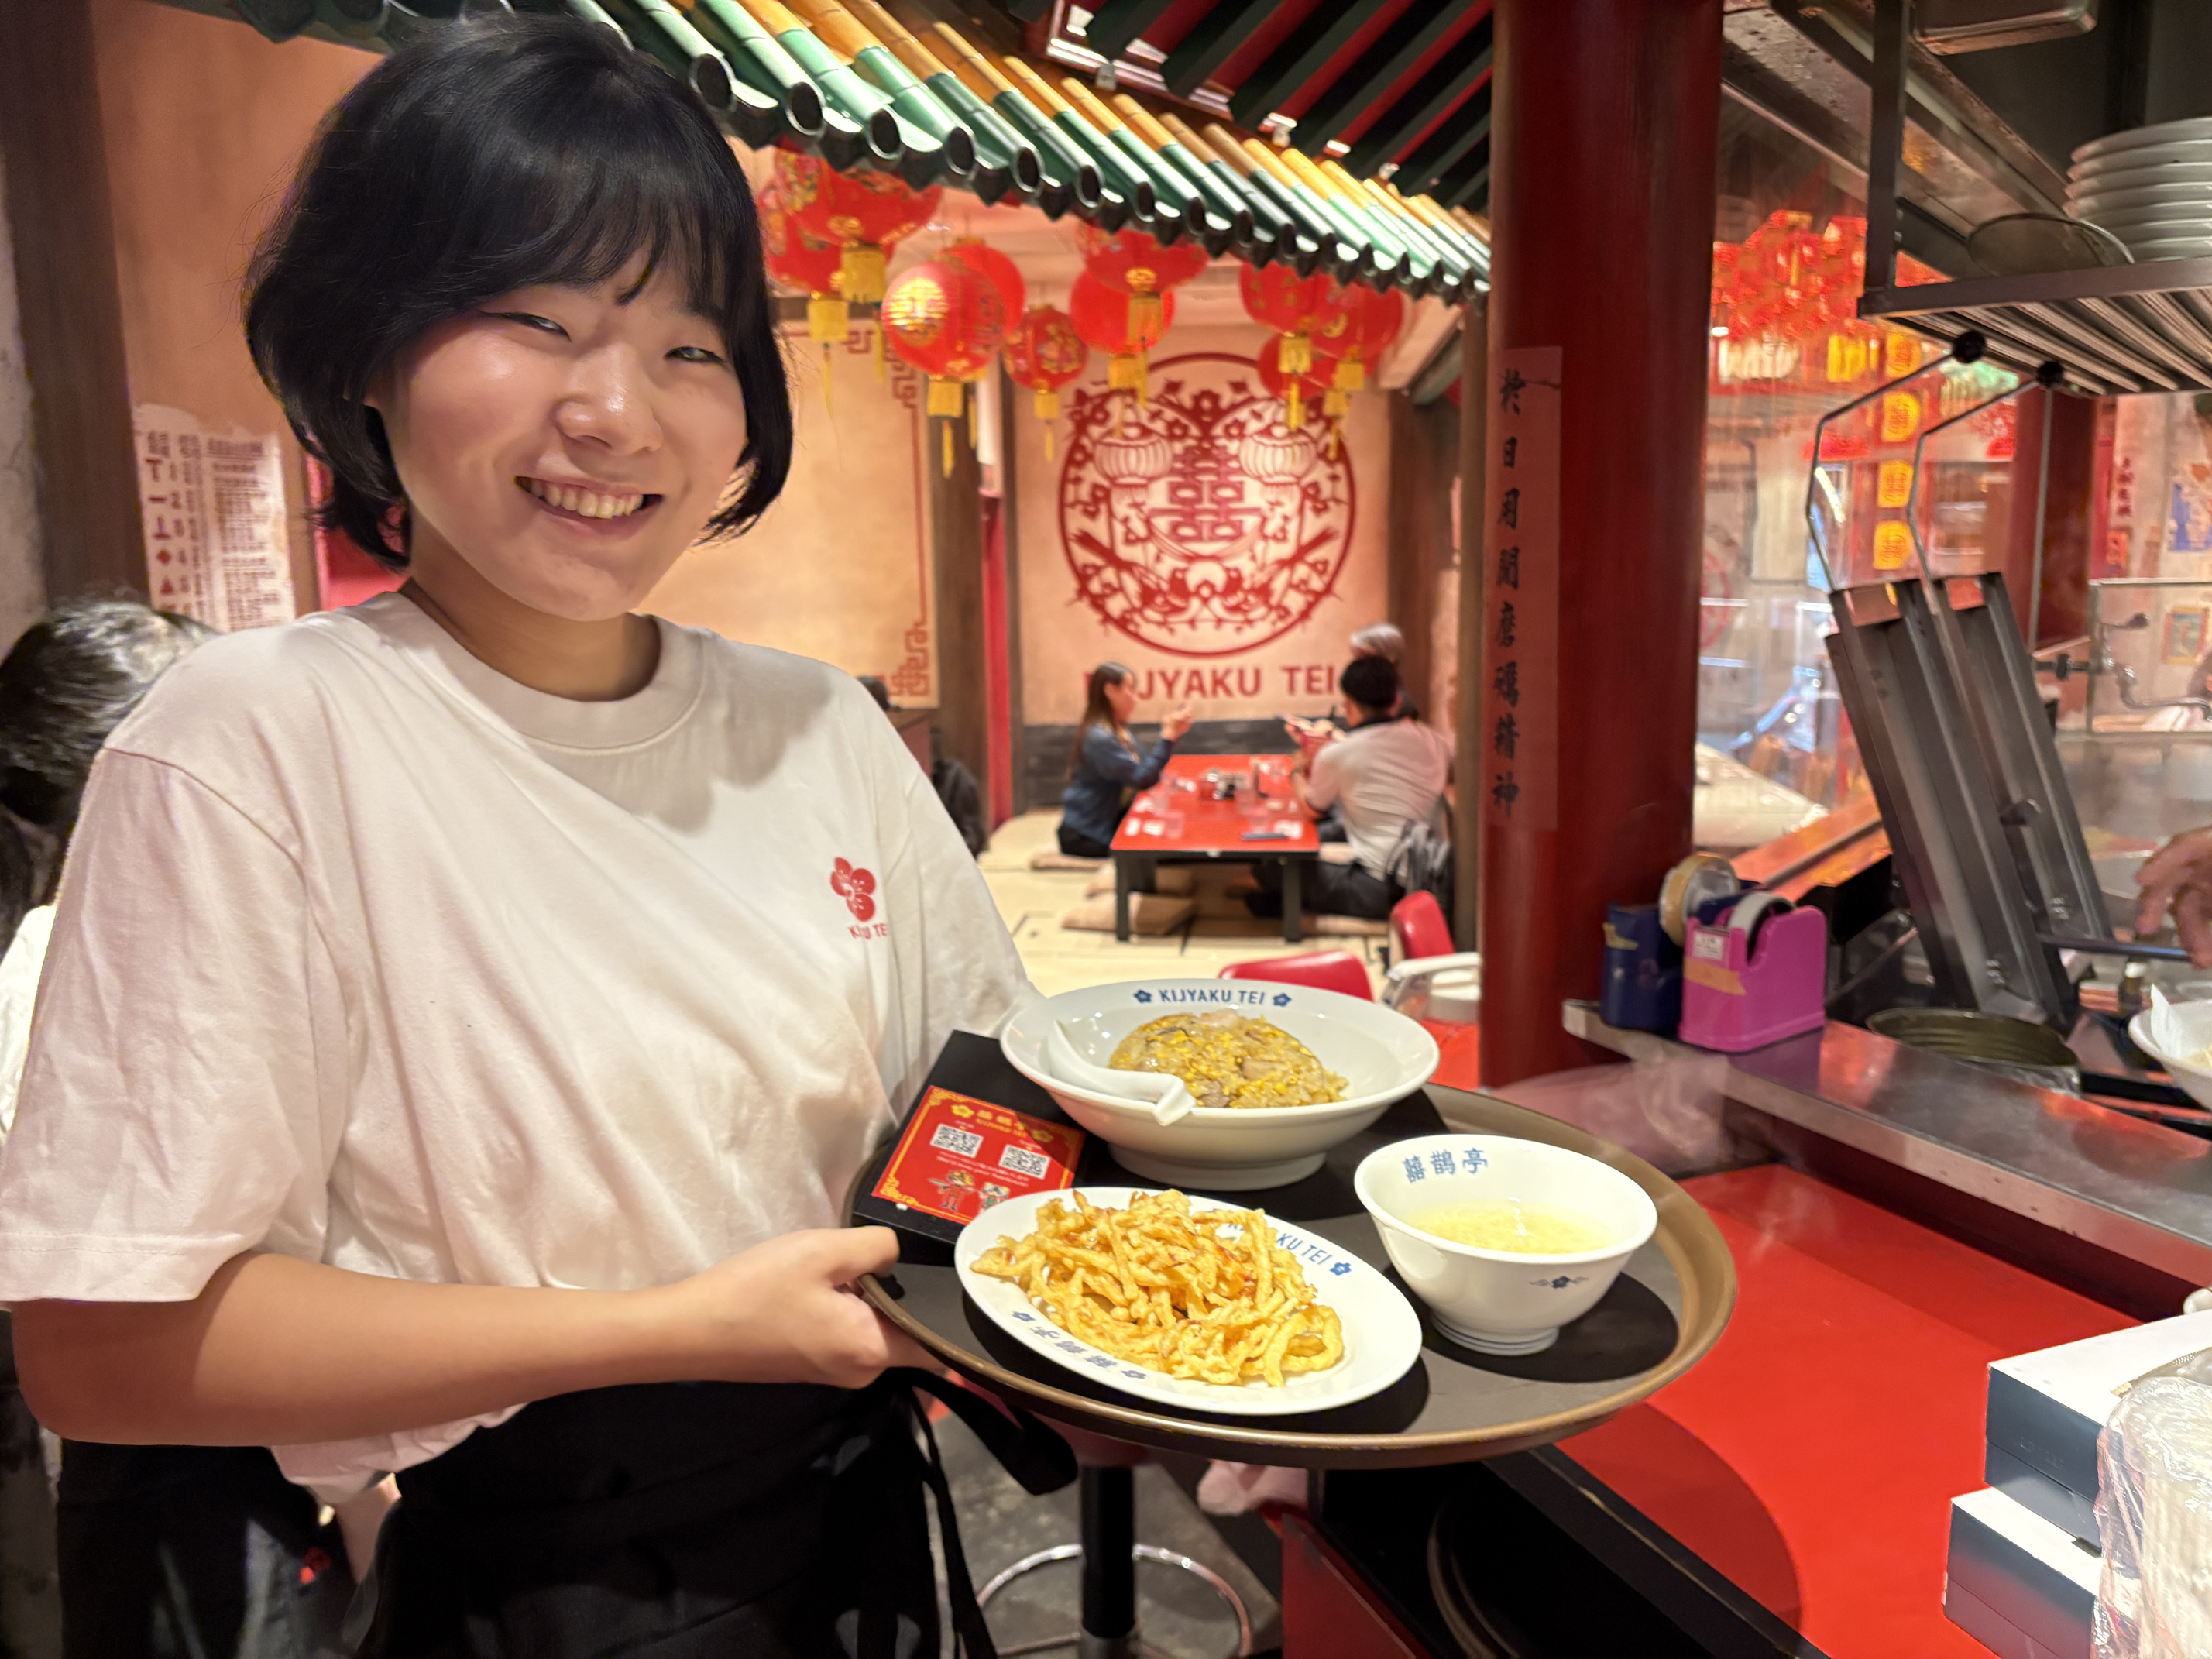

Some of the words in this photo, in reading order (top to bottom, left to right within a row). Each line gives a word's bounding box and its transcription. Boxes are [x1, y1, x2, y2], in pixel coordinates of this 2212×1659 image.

[1084, 666, 1262, 700] JYAKU
[1279, 665, 1334, 696] TEI
[1159, 989, 1231, 1004] KIJYAKU
[1238, 991, 1265, 1005] TEI
[1300, 1244, 1334, 1266] TEI
